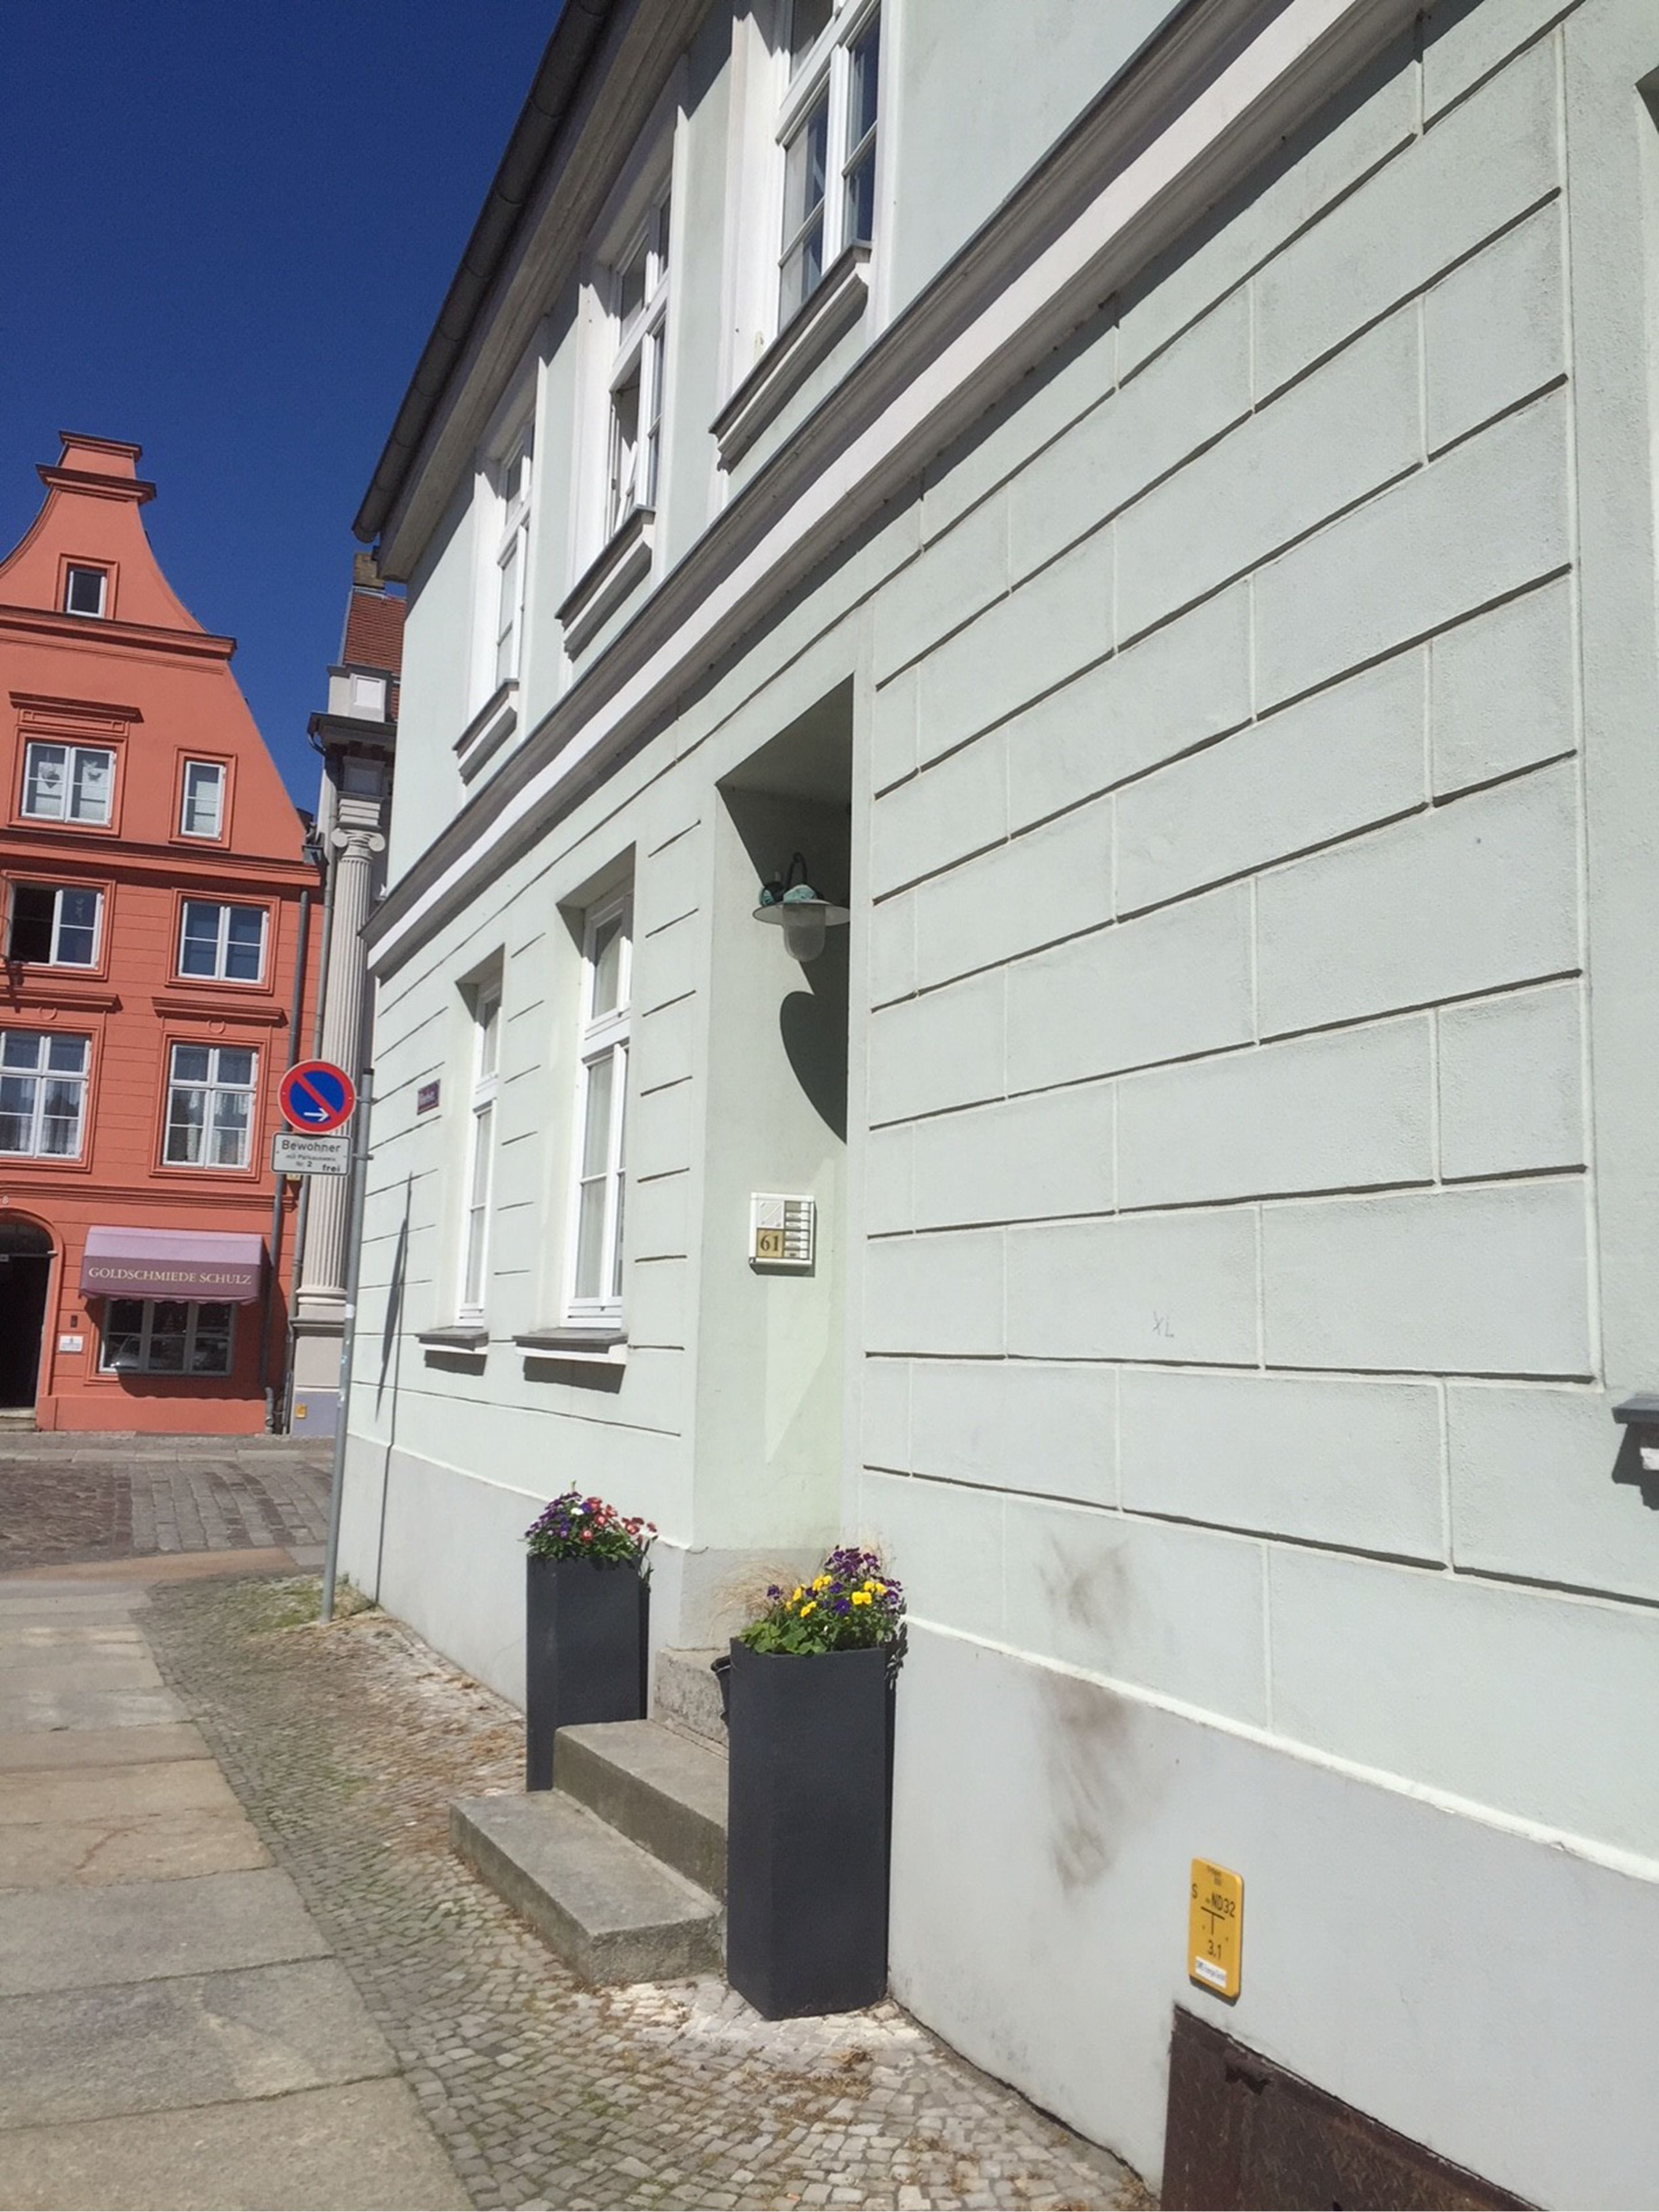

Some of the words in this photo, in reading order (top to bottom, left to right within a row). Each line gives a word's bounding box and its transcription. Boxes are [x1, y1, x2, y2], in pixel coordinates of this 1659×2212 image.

[282, 1140, 341, 1152] Bewohner
[760, 1234, 779, 1251] 61
[89, 1267, 196, 1282] GOLDSCHMIEDE
[199, 1273, 252, 1285] SCHULZ
[1191, 1883, 1198, 1899] S
